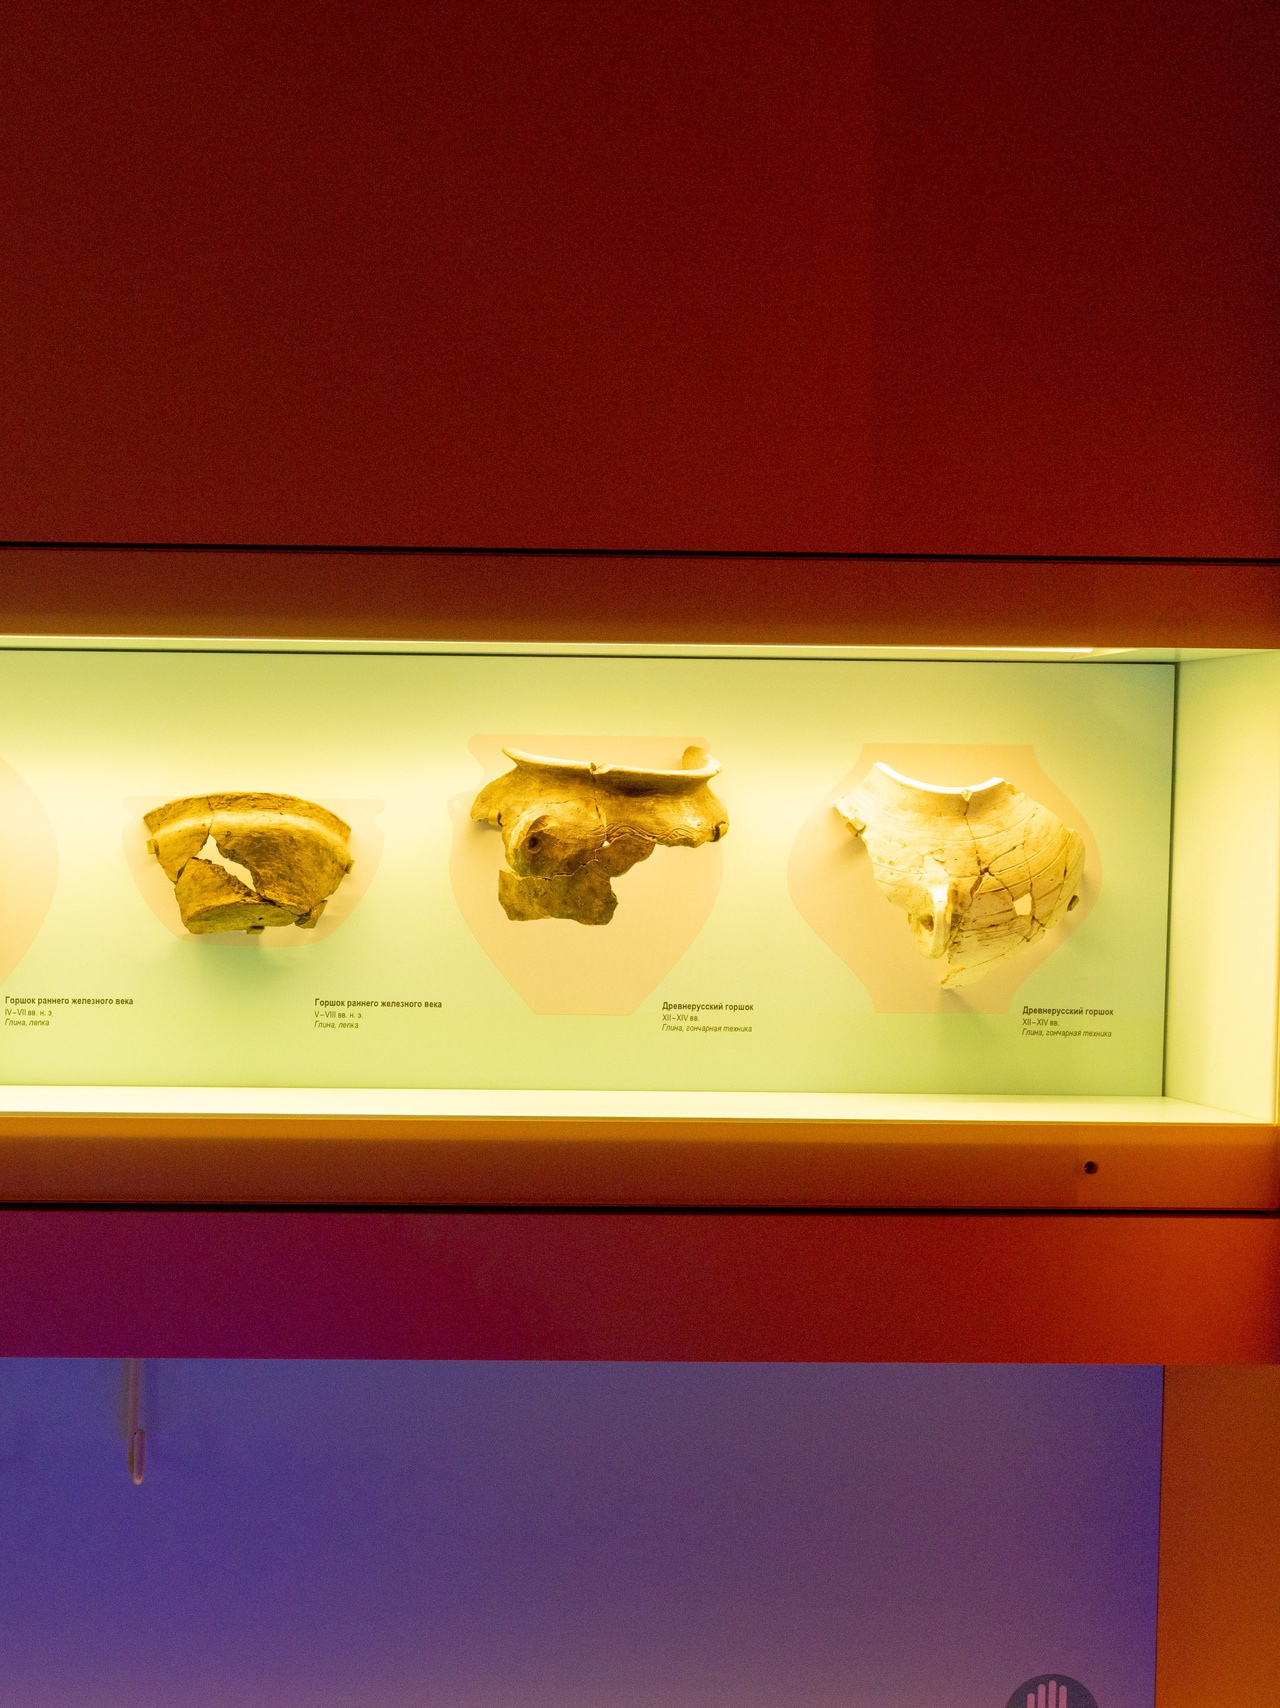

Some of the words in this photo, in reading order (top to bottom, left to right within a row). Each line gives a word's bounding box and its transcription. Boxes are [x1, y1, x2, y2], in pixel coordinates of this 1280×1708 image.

[5, 996, 35, 1005] Горшок
[38, 997, 69, 1006] раннего
[72, 997, 113, 1005] железного
[315, 998, 345, 1008] Горшок
[347, 1000, 379, 1008] раннего
[381, 1000, 422, 1008] железного
[662, 1002, 723, 1012] Древнерусский
[725, 1004, 753, 1012] горшок
[1022, 1006, 1083, 1016] Древнерусский
[1085, 1009, 1113, 1017] горшок
[5, 1018, 27, 1026] Глина,
[314, 1021, 337, 1029] Глина,
[662, 1024, 684, 1032] Глина,
[1022, 1028, 1043, 1036] Глина,
[1046, 1030, 1081, 1038] гончарная
